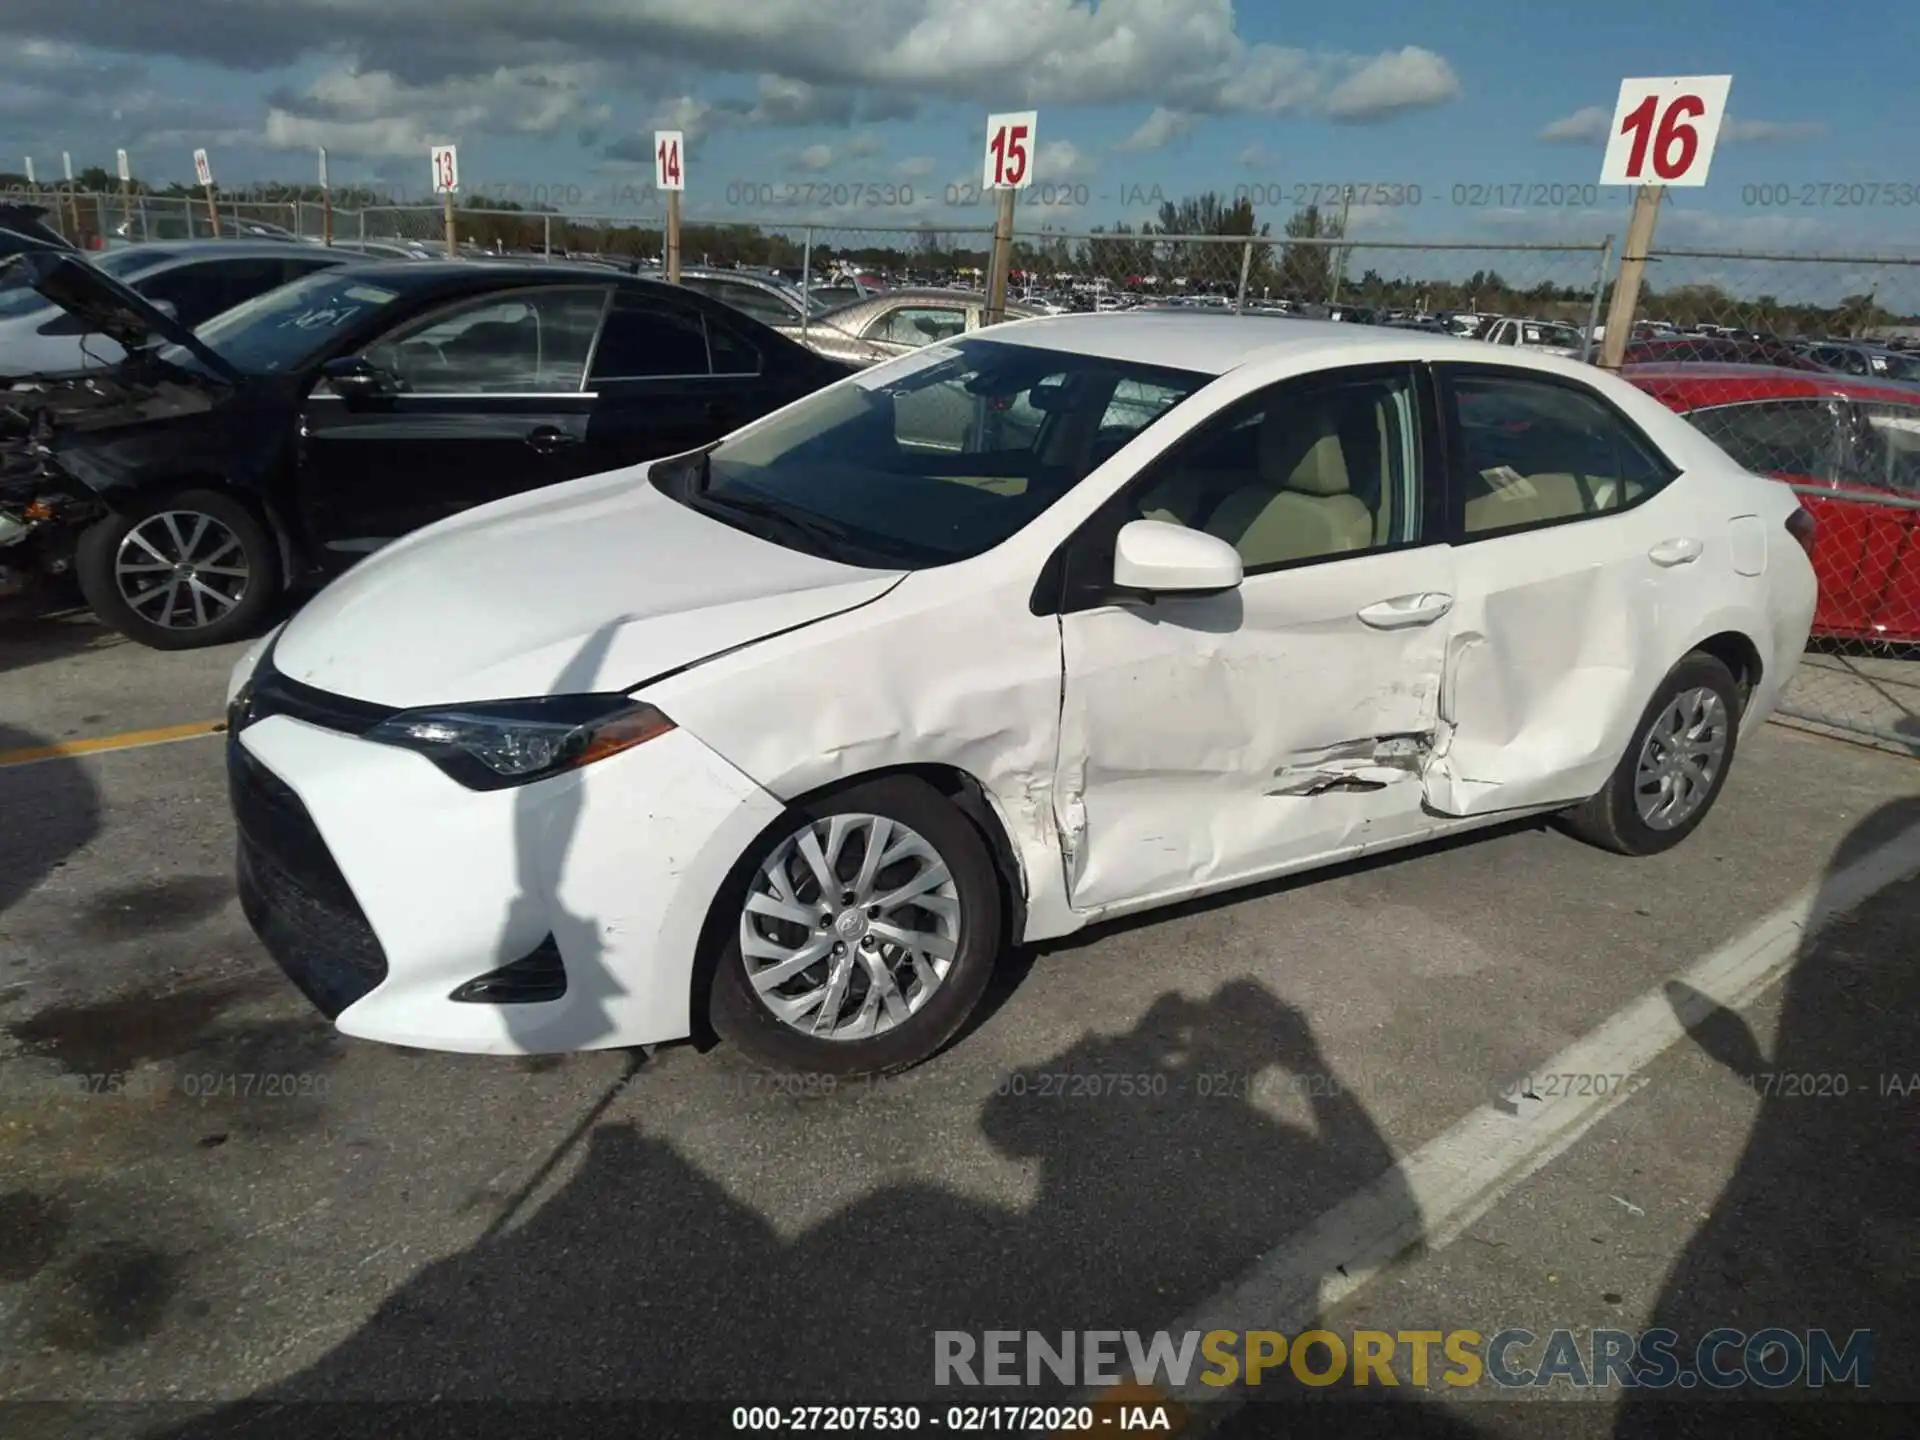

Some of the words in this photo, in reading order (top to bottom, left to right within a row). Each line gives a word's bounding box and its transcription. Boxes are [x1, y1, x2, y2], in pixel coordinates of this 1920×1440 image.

[658, 140, 680, 184] 14
[992, 127, 1027, 184] 15
[1623, 96, 1705, 179] 16
[434, 150, 453, 187] 13
